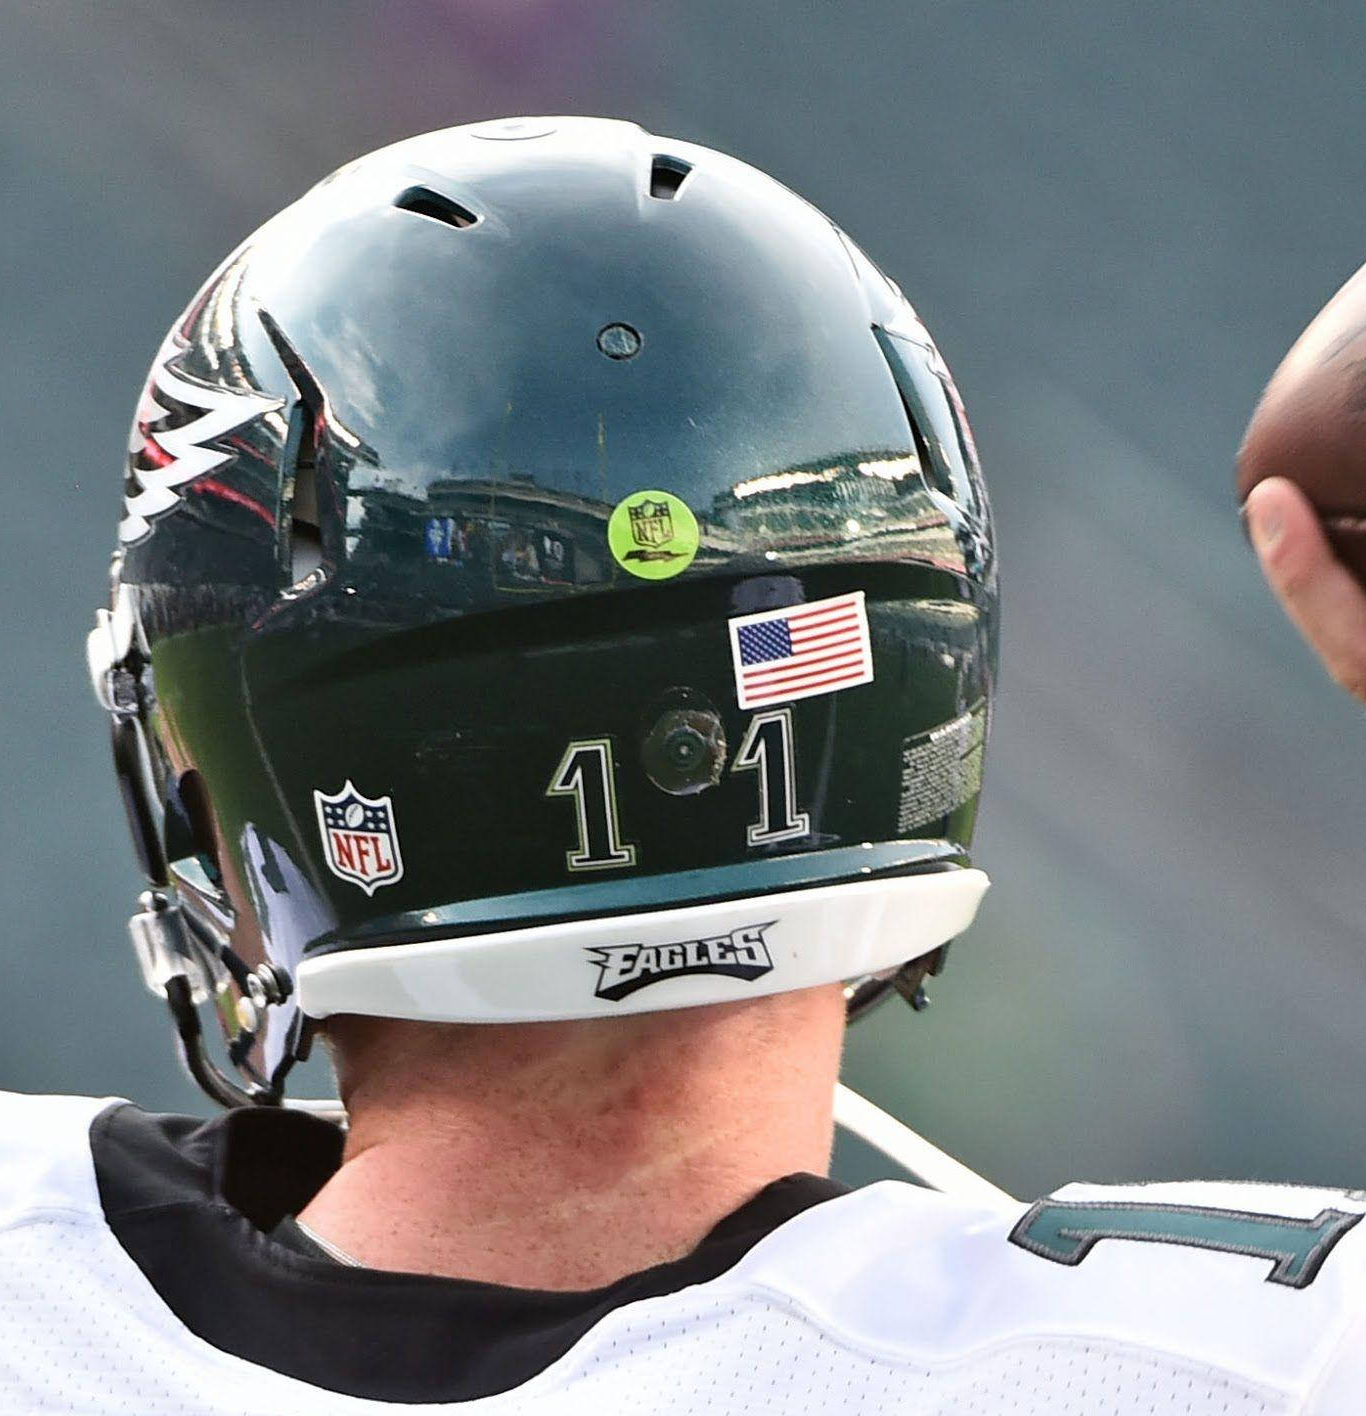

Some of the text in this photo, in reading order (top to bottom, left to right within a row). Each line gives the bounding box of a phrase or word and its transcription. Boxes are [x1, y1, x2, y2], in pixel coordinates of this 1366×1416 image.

[634, 518, 673, 543] NFL
[332, 832, 392, 877] NFL
[583, 920, 779, 1001] EAGLES
